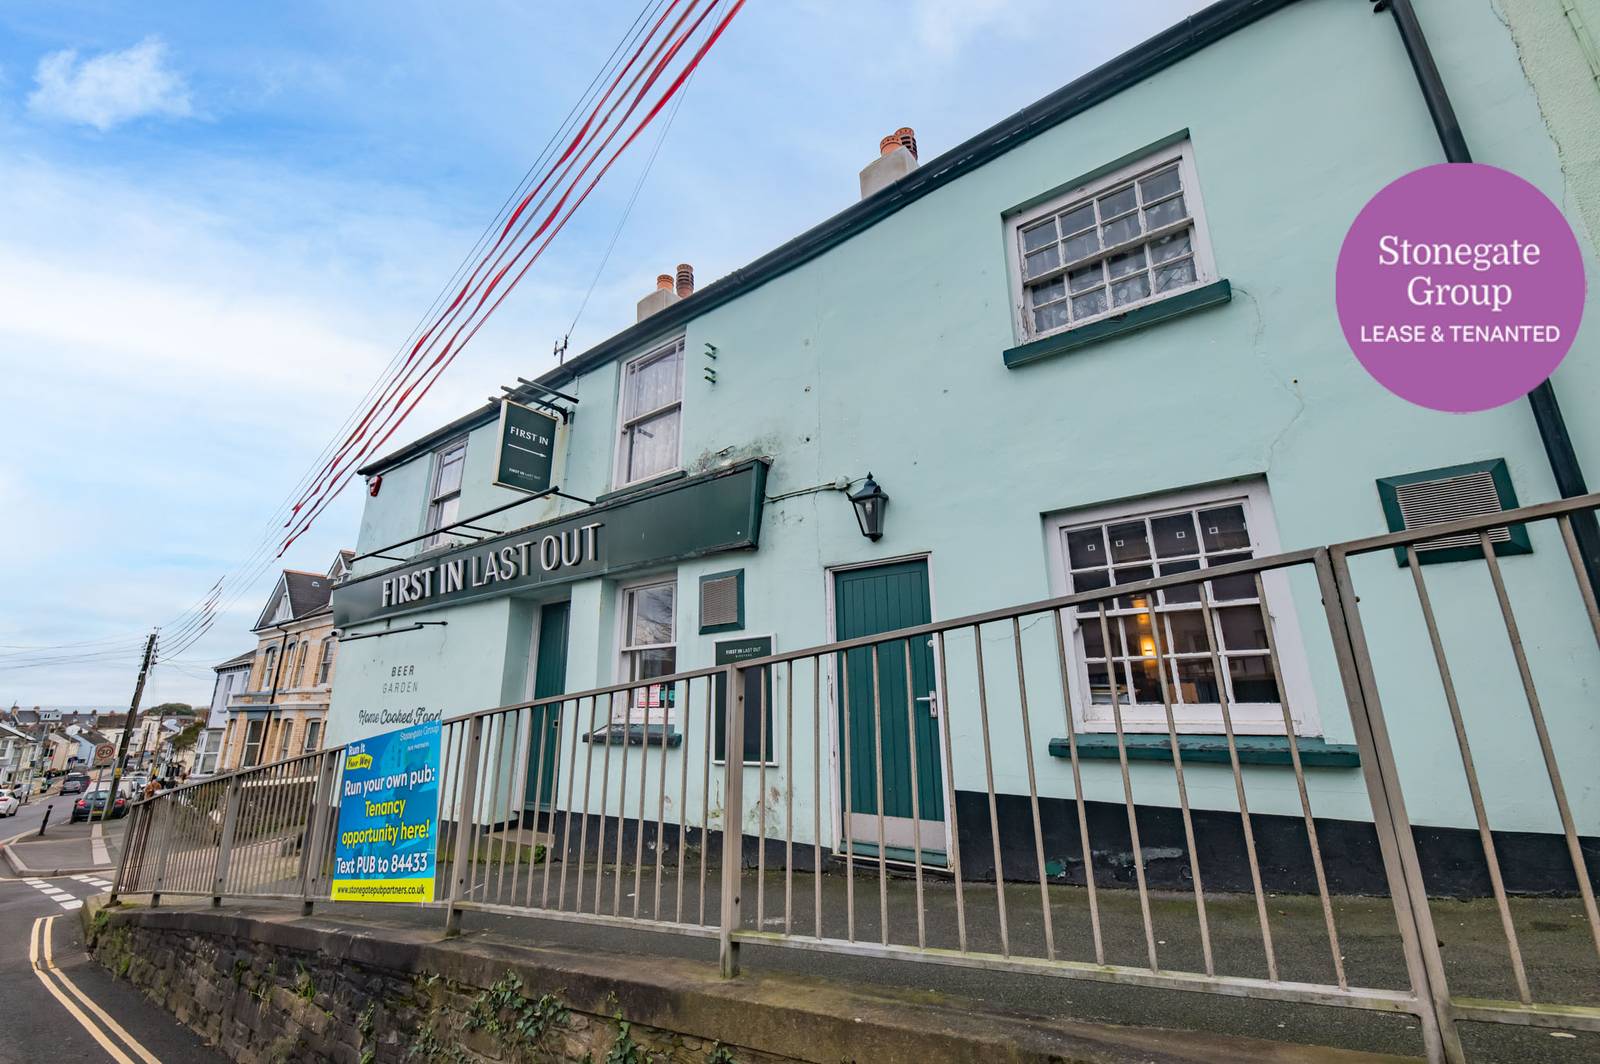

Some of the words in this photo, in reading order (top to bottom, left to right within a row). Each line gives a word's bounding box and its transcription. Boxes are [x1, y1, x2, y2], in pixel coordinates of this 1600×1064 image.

[510, 426, 537, 441] FIRST
[539, 435, 549, 446] IN
[381, 566, 436, 607] FIRST
[440, 559, 465, 594] IN
[471, 541, 536, 587] LAST
[540, 522, 604, 571] OUT
[391, 665, 415, 677] BEER
[382, 681, 418, 694] GARDEN
[358, 709, 379, 726] Home
[380, 709, 414, 725] Cooked
[413, 706, 443, 726] Food
[348, 745, 359, 756] Run
[344, 780, 361, 797] Run
[363, 777, 385, 798] your
[386, 772, 408, 790] own
[409, 763, 435, 791] pub:
[365, 799, 406, 819] Tenancy
[341, 823, 399, 849] opportunity
[400, 818, 430, 840] here!
[336, 857, 355, 874] Text
[356, 855, 376, 874] PUB
[377, 856, 389, 873] to
[391, 852, 428, 873] 84433
[337, 884, 425, 897] www.stonegatepubpartners.co.uk
